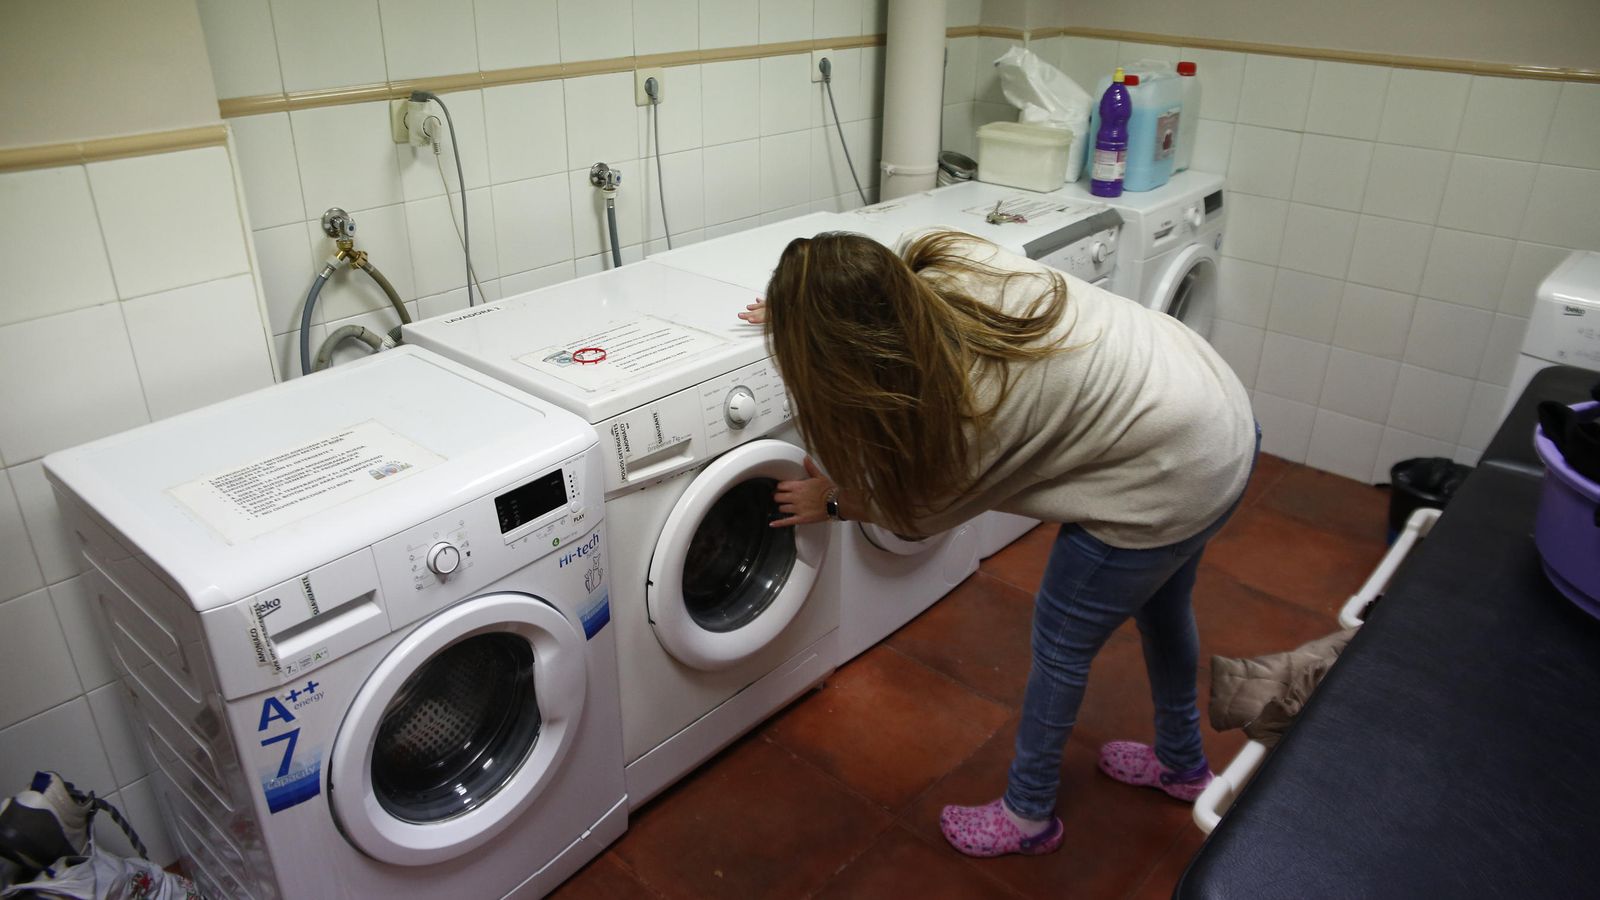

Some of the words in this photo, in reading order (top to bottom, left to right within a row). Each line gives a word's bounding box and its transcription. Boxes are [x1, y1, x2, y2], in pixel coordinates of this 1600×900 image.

[613, 424, 624, 459] DETERGENTES
[620, 424, 630, 452] AMONIACO
[654, 412, 663, 444] SUAVIZANTE
[574, 514, 585, 522] PLAY
[559, 533, 600, 568] Hi-tech
[258, 598, 280, 612] eko
[250, 628, 266, 663] AMONIACO
[258, 680, 320, 732] A++
[294, 690, 325, 710] energy
[260, 728, 300, 778] 7
